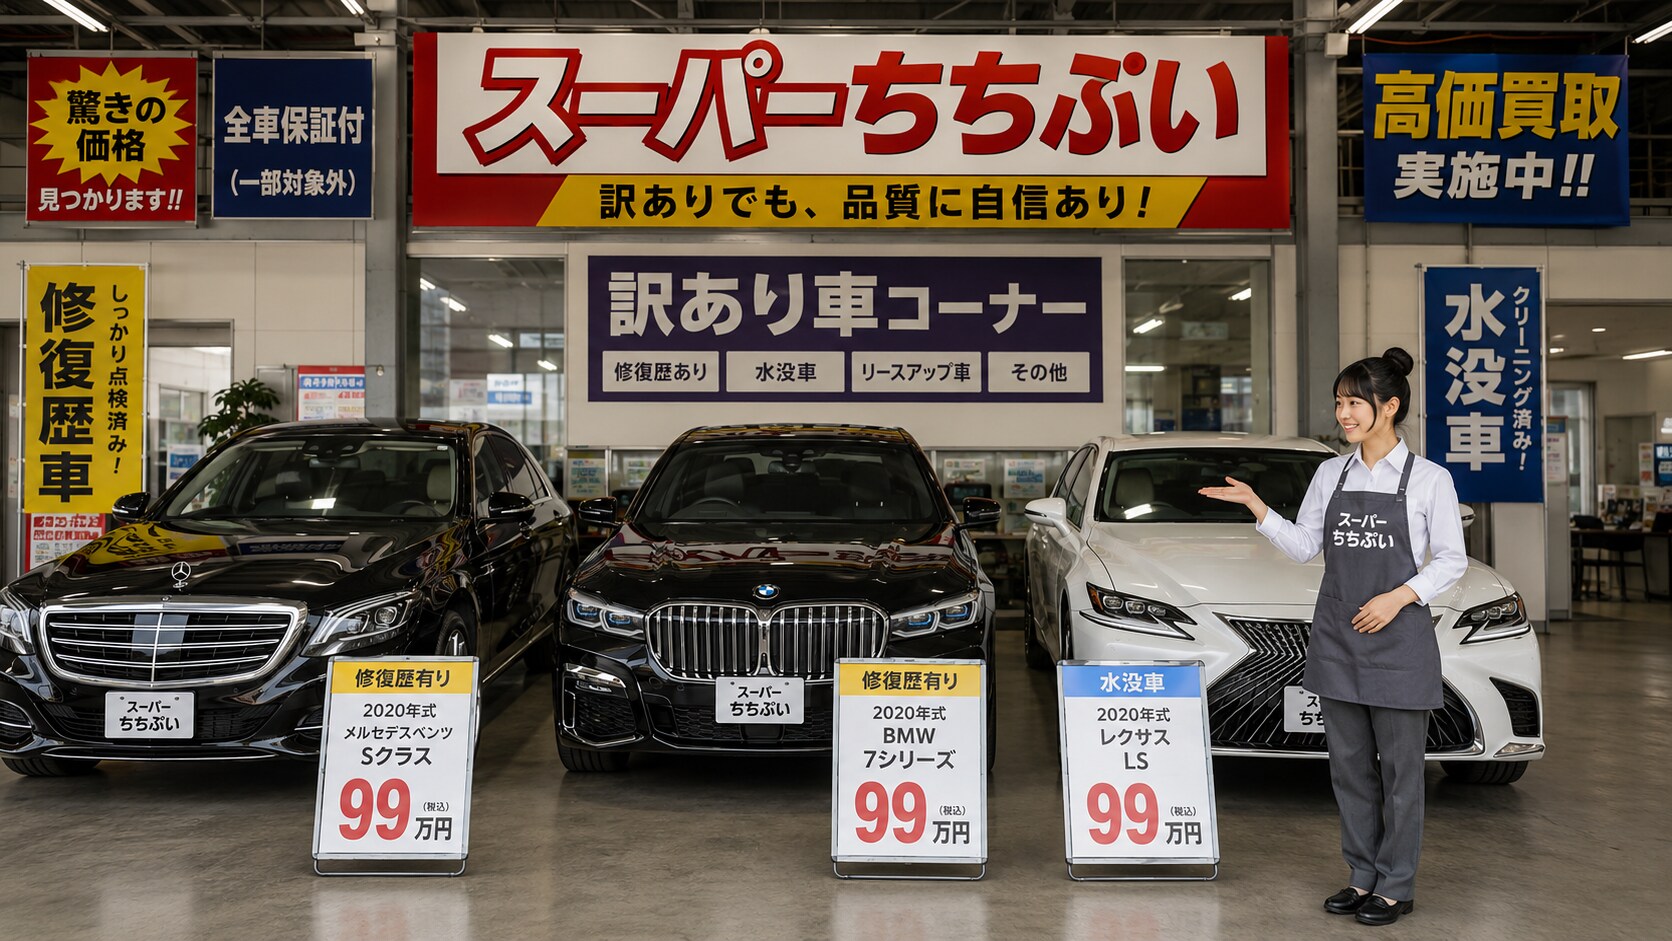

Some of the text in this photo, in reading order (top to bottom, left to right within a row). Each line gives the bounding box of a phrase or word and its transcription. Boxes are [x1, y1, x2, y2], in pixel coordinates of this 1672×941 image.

[67, 90, 166, 125] 驚きの
[463, 39, 1239, 166] スーパーちちぷい
[1375, 71, 1620, 139] 高価買取
[224, 106, 365, 145] 全車保証付
[76, 128, 146, 162] 価格
[231, 169, 356, 197] （一部対象外）
[1394, 151, 1595, 199] 実施中!!
[38, 188, 183, 211] 見つかります!!
[599, 184, 1151, 221] 訳ありでも、品質に自信あり！
[608, 271, 1087, 337] 訳あり車コーナー
[107, 285, 129, 474] しっかり点検済み！
[614, 362, 707, 382] 修復歴あり
[755, 362, 817, 383] 水没車
[862, 362, 971, 383] リースアップ車
[1011, 362, 1068, 383] その他
[1444, 283, 1506, 472] 水没車
[1512, 286, 1533, 471] クリーニング済み！
[38, 281, 97, 503] 修復歴車
[1338, 512, 1388, 529] スーパー
[1332, 529, 1394, 549] ちちぷい
[355, 668, 450, 689] 修復歴有り
[861, 670, 958, 691] 修復歴有り
[1100, 672, 1165, 693] 水没車
[363, 703, 437, 719] 2020年式
[729, 701, 790, 717] ちちぷい
[872, 705, 947, 721] 2020年式
[1097, 707, 1171, 723] 2020年式
[1299, 710, 1325, 726] ちち
[119, 716, 180, 731] ちちぷい
[344, 725, 453, 740] メルセデスベンツ
[883, 727, 936, 744] BMW
[1100, 728, 1171, 746] レクサス
[360, 747, 432, 766] Sクラス
[863, 750, 957, 770] 7シリーズ
[1124, 752, 1149, 770] LS
